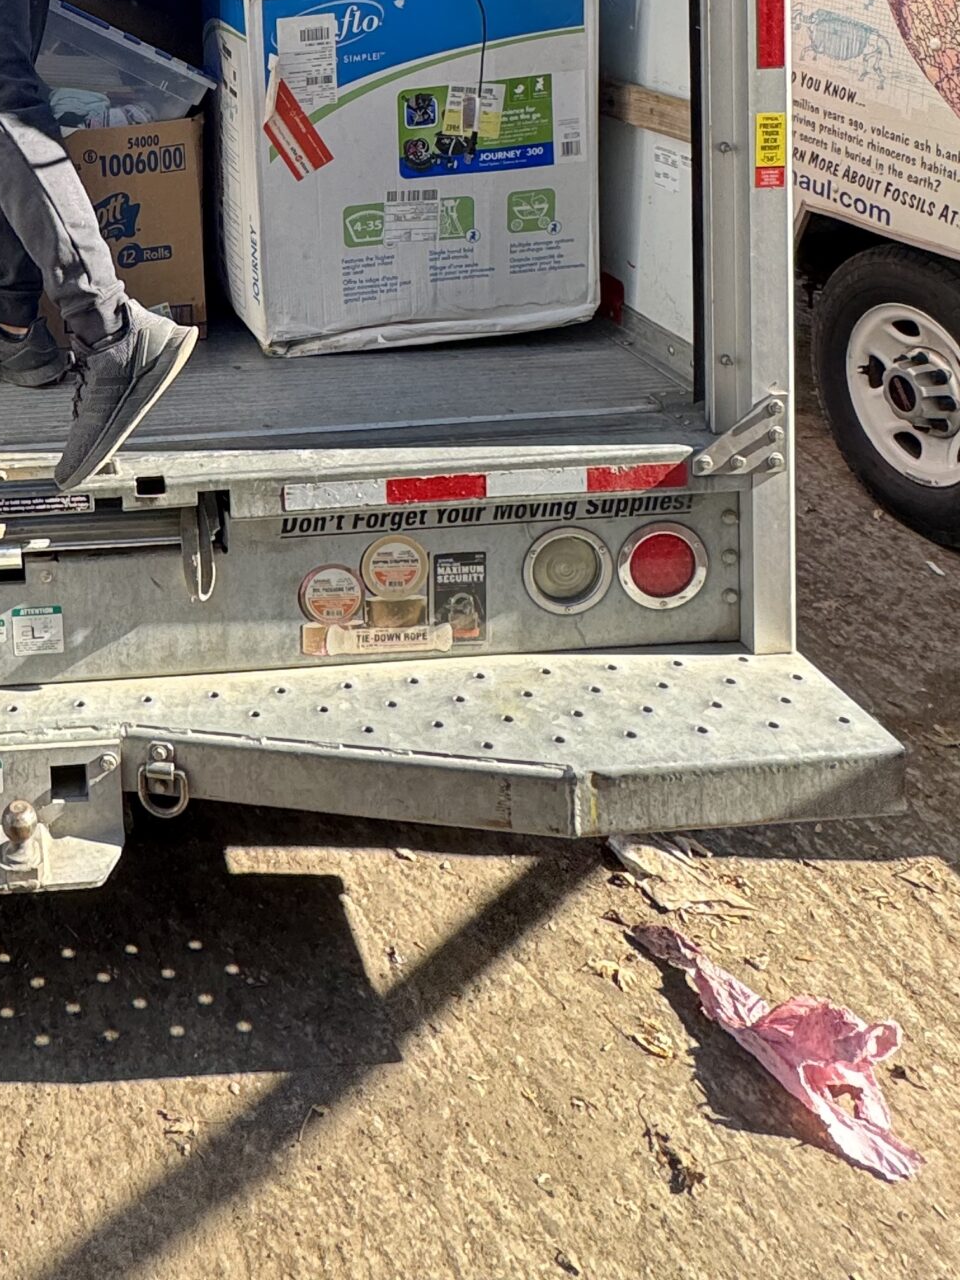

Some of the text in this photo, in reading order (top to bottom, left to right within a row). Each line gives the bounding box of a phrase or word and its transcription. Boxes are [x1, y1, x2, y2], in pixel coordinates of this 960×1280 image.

[336, 5, 382, 41] flo
[127, 134, 160, 150] 54000
[823, 109, 845, 124] years
[871, 125, 910, 146] volcanic
[914, 139, 931, 153] ash
[479, 146, 544, 162] JOURNEY 300
[820, 123, 864, 147] prehistoric
[867, 139, 917, 166] rhinoceros
[800, 133, 942, 193] secrets lie buried in the earth?
[808, 150, 840, 177] MORE
[842, 165, 882, 194] ABOUT
[883, 182, 936, 217] FOSSILS
[353, 220, 383, 231] 4-35
[123, 248, 170, 263] 12 Rolls
[249, 223, 261, 306] JOURNEY
[351, 509, 426, 531] Forget
[435, 505, 486, 524] Your
[493, 500, 577, 521] Moving
[585, 493, 694, 516] Supplies!
[437, 565, 484, 575] MAXIMUM
[437, 573, 484, 583] SECURITY
[356, 631, 428, 643] TIE-DOWN ROPE
